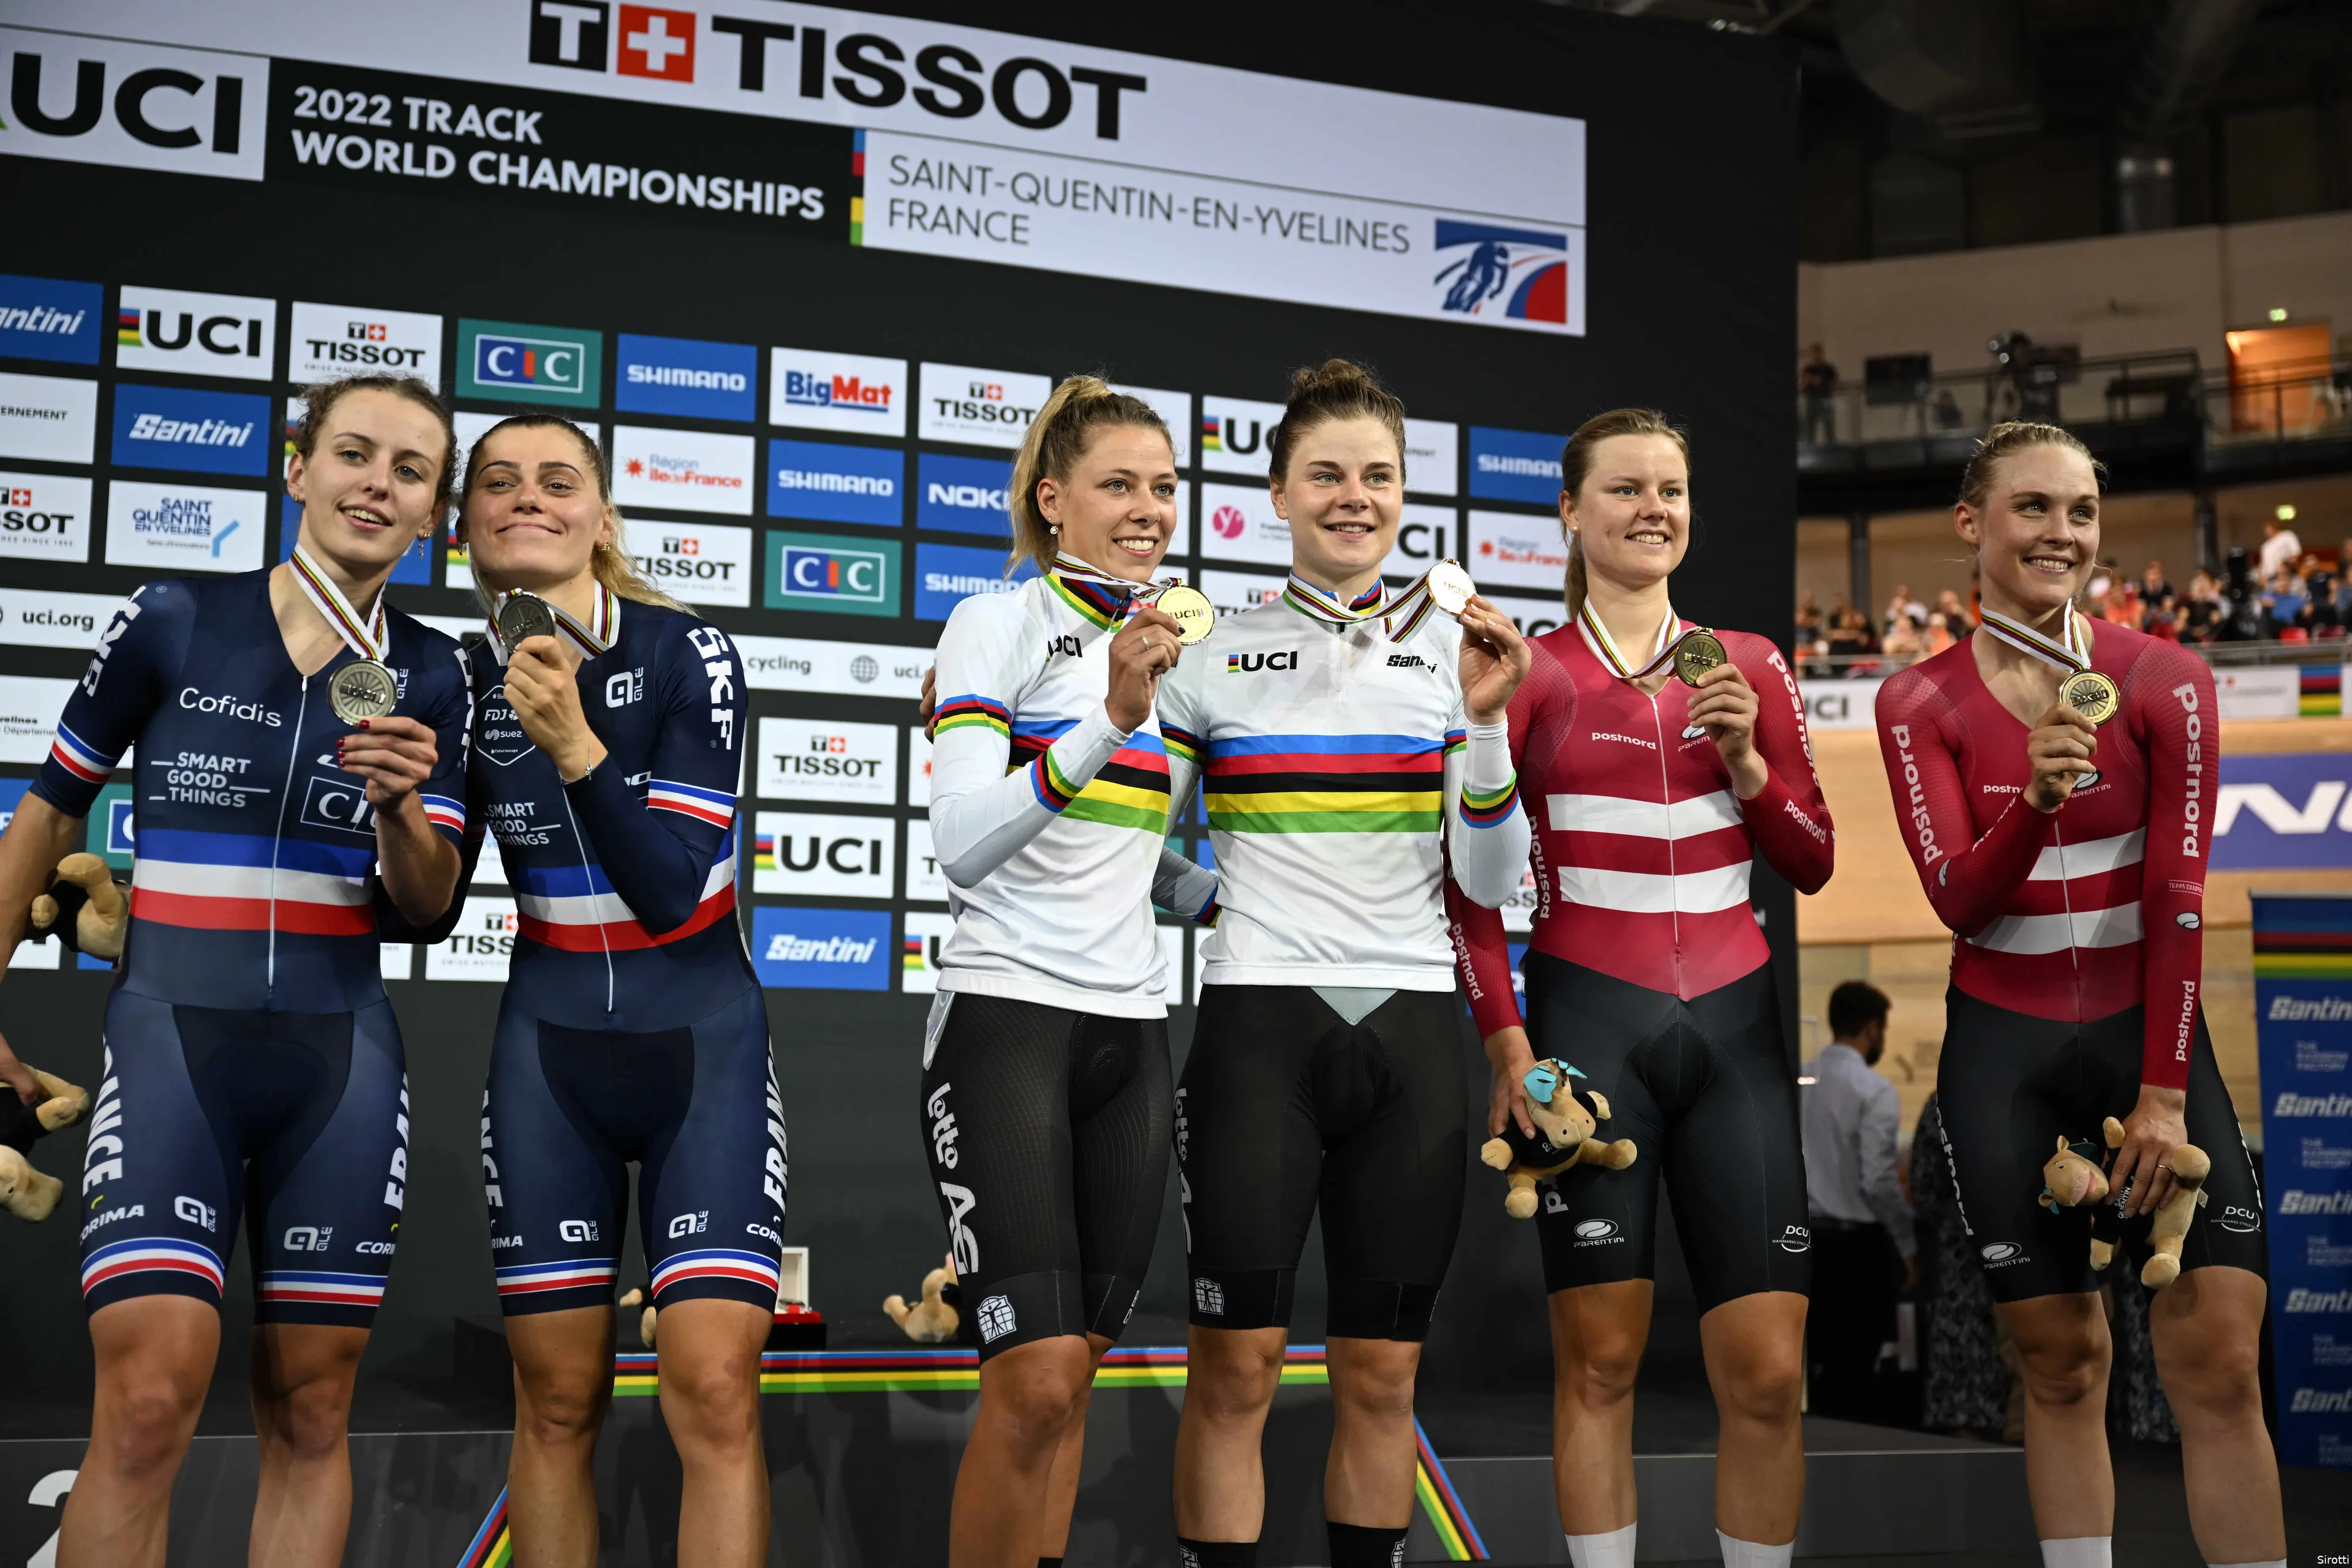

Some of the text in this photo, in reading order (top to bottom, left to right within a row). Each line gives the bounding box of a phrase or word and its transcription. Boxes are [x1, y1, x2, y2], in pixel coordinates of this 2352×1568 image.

[712, 15, 1147, 140] TISSOT
[10, 51, 243, 154] UCI
[293, 85, 544, 145] 2022 TRACK
[292, 129, 825, 221] WORLD CHAMPIONSHIPS
[889, 154, 1410, 255] SAINT-QUENTIN-EN-YVELINES
[889, 198, 1030, 245] FRANCE
[146, 310, 262, 358] UCI
[306, 339, 426, 368] TISSOT
[488, 345, 572, 382] CIC
[627, 364, 746, 391] SHIMANO
[785, 371, 891, 406] BigMat
[129, 413, 254, 448] Santini
[1478, 453, 1563, 479] SHIMAN
[778, 470, 894, 496] SHIMANO
[161, 497, 213, 513] SAINT
[929, 483, 1009, 511] NOK
[0, 510, 74, 535] SOT
[132, 508, 211, 526] QUENTIN
[135, 523, 211, 537] EN YVELINES
[1399, 524, 1444, 559] CI
[793, 556, 873, 592] CIC
[23, 610, 94, 631] uci.org
[895, 663, 929, 679] uci.
[1241, 651, 1298, 672] UCI
[686, 627, 734, 750] SKF
[179, 687, 282, 728] Cofidis
[484, 709, 508, 721] FDJ
[1805, 694, 1849, 720] CI
[1592, 731, 1656, 750] postnord
[176, 752, 251, 774] SMART
[774, 754, 882, 778] TISSOT
[2172, 682, 2201, 858] postnord
[167, 769, 227, 789] GOOD
[1983, 784, 2024, 794] postn
[2070, 783, 2111, 798] ARENTINI
[169, 786, 246, 808] THINGS
[1891, 725, 1943, 865] postnord
[488, 802, 535, 818] SMART
[1784, 799, 1826, 845] postnord
[491, 820, 527, 834] GOOD
[782, 835, 881, 875] UCI
[1531, 816, 1550, 919] postnord
[450, 935, 513, 956] TISS
[766, 934, 876, 964] Santini
[1451, 922, 1483, 1000] postnord
[2175, 981, 2195, 1061] postnord
[2269, 995, 2352, 1021] Santin
[927, 1082, 959, 1169] lotto
[2225, 1206, 2255, 1219] DCU
[492, 1235, 523, 1249] RIMA
[1785, 1225, 1809, 1237] DCU
[356, 1241, 396, 1256] CORI
